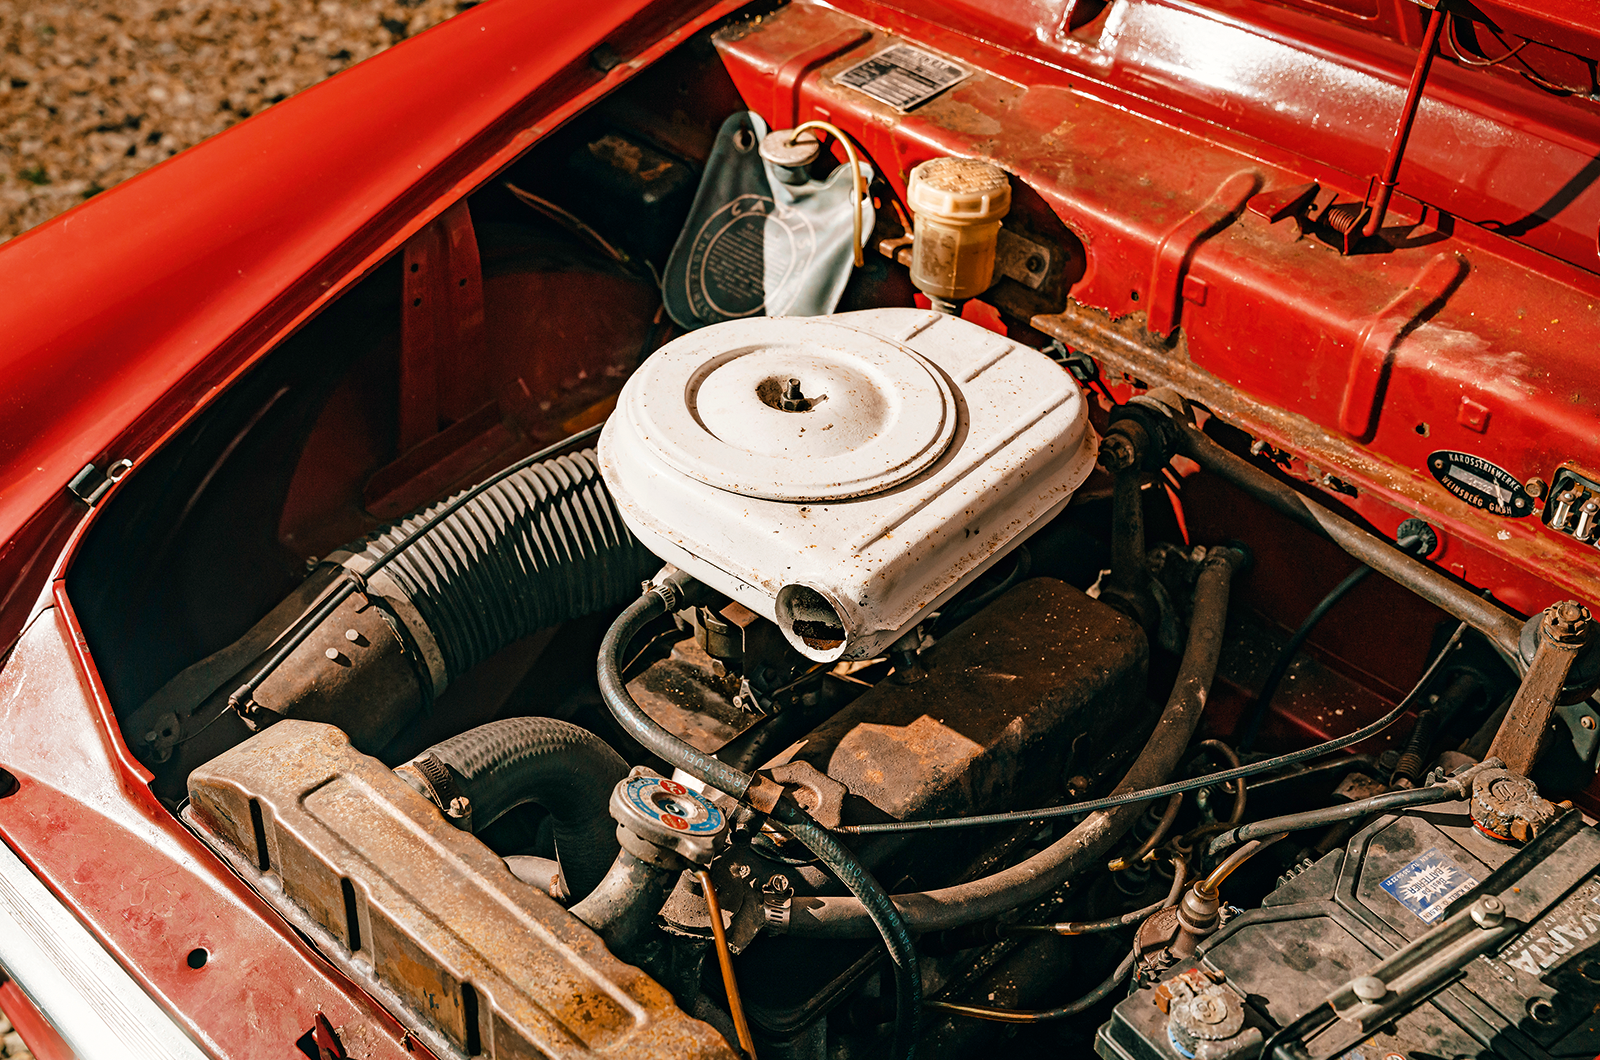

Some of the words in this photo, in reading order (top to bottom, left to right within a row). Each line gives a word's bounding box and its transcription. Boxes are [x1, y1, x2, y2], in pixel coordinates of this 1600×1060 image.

[1448, 453, 1521, 492] KAROSSERIEWERKE
[1441, 475, 1483, 507] WEINSBERG
[682, 749, 713, 773] FUEL
[846, 860, 867, 884] FOR
[1407, 867, 1444, 894] BATTERIER
[1430, 877, 1447, 890] Best
[1423, 904, 1441, 920] OLSEN
[1507, 910, 1600, 976] VARTA
